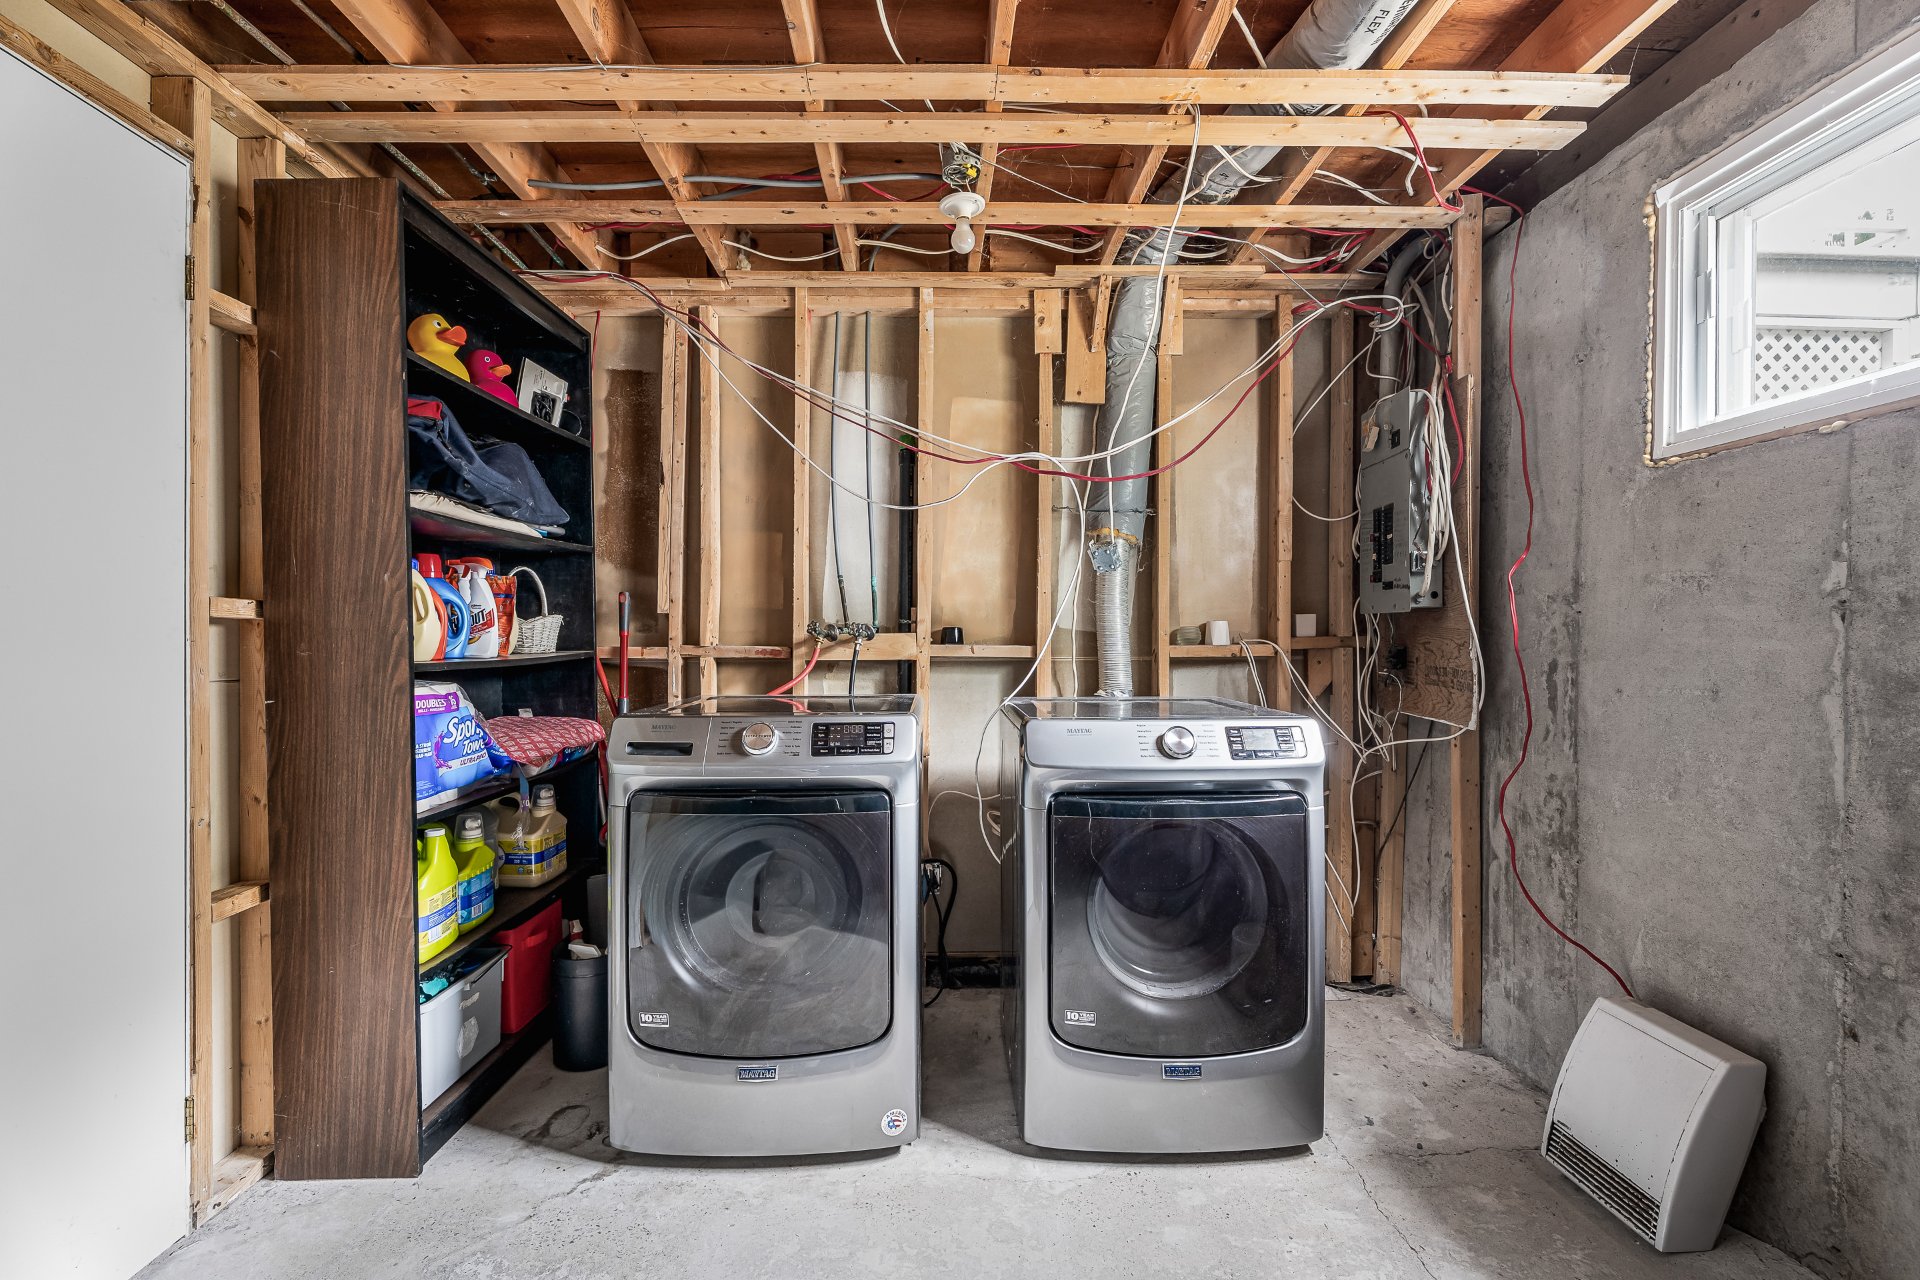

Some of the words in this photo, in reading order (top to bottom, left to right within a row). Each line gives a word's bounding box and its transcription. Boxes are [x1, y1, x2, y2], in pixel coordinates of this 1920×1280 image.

[1364, 9, 1390, 34] FLEX
[416, 699, 447, 709] DOUBLES
[640, 1013, 653, 1022] 10
[1066, 1011, 1079, 1021] 10
[740, 1069, 775, 1079] MAYTAG
